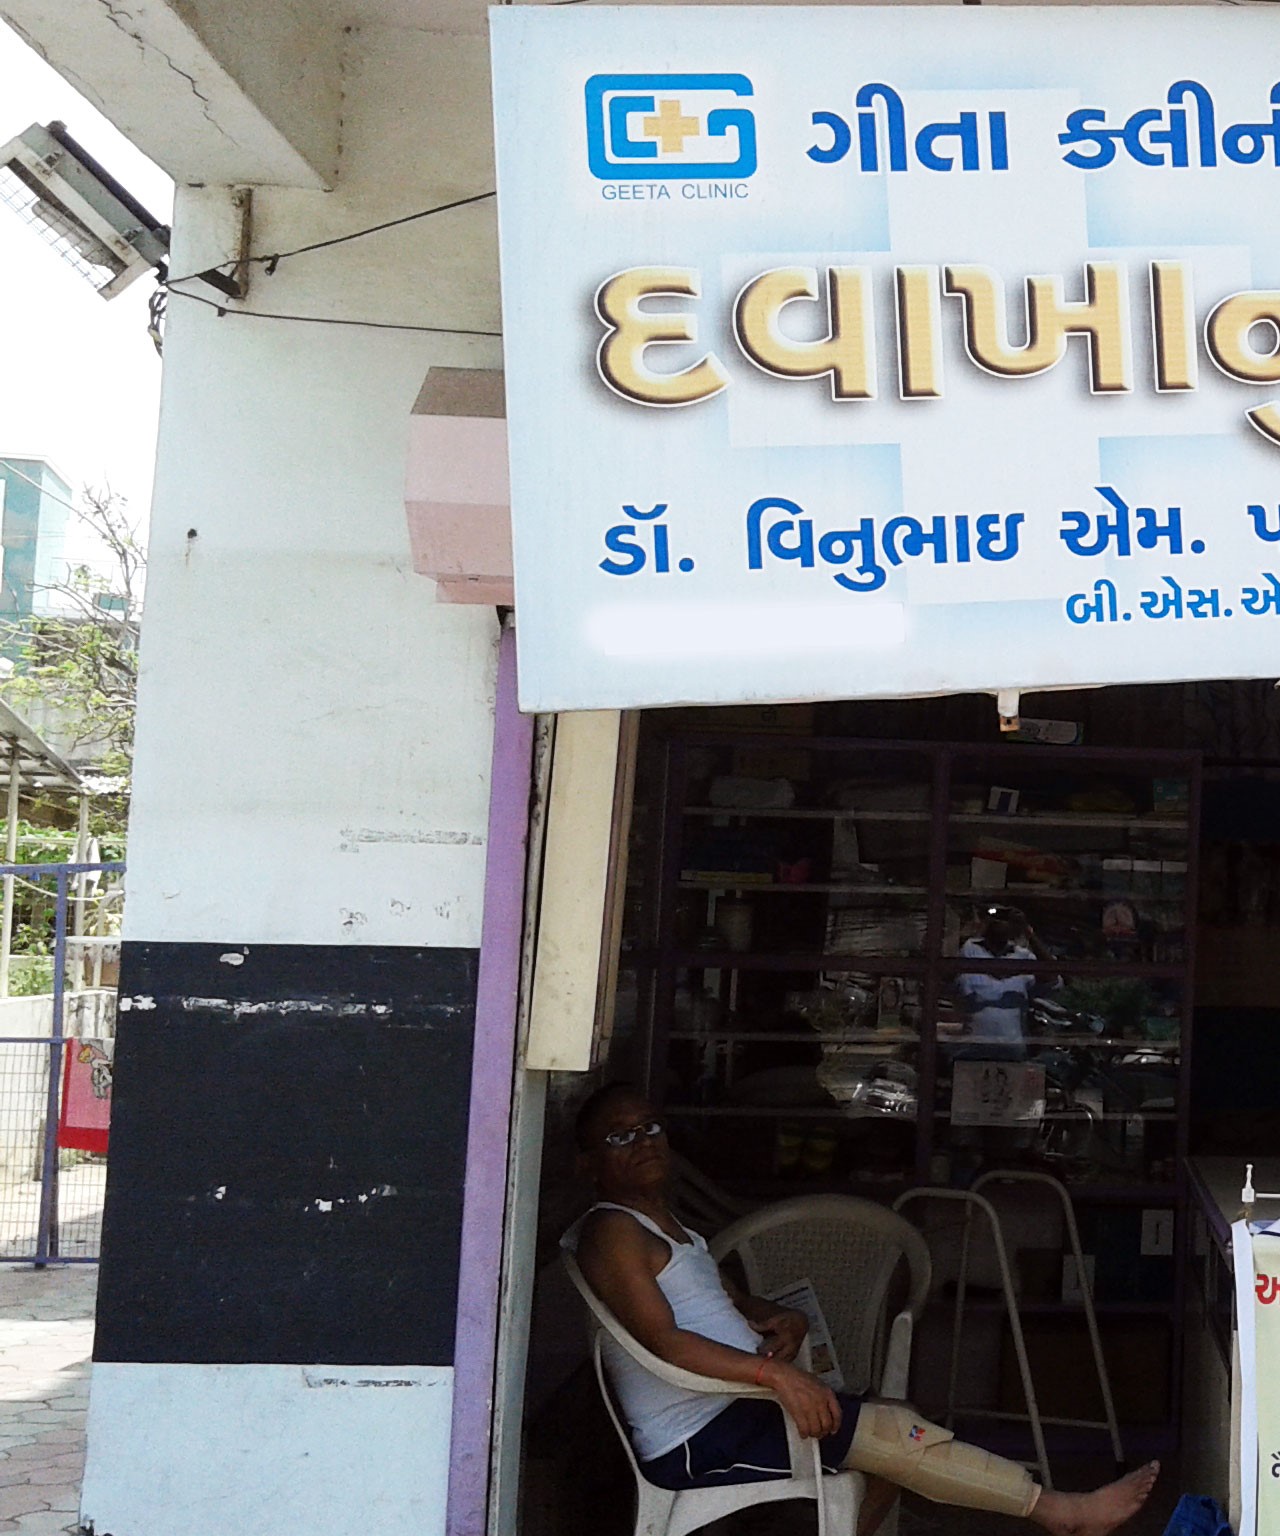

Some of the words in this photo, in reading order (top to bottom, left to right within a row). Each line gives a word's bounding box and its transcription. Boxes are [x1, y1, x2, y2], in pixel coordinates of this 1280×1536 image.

[806, 83, 1009, 173] ગીતા
[601, 183, 671, 201] GEETA
[681, 182, 749, 200] CLINIC
[598, 503, 695, 576] ડૉ.
[745, 497, 1025, 593] વિનુભાઇ
[1059, 486, 1206, 558] એમ.
